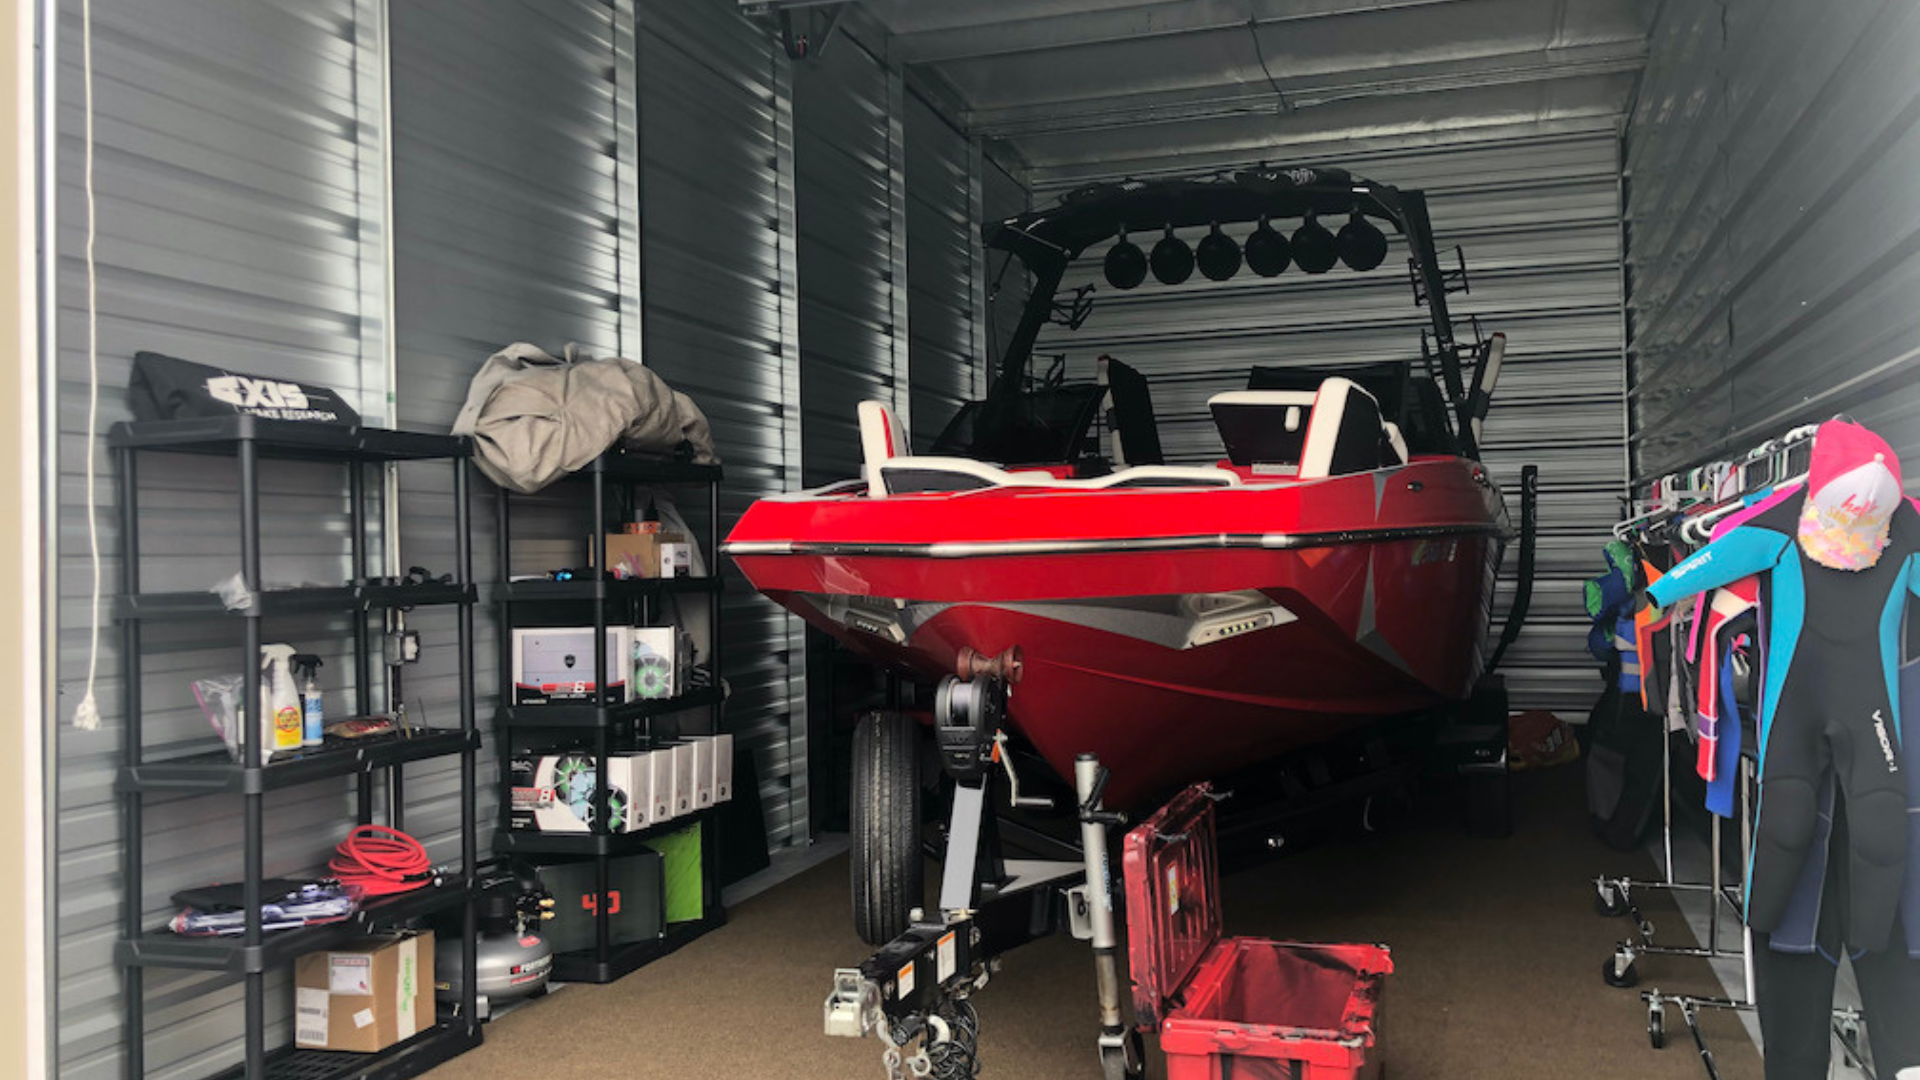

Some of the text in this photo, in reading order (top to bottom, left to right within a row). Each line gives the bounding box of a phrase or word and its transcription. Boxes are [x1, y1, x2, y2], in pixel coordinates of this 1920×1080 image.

[206, 375, 309, 409] AXIS
[281, 409, 338, 421] RESEARCH
[1671, 551, 1712, 580] SPIRIT
